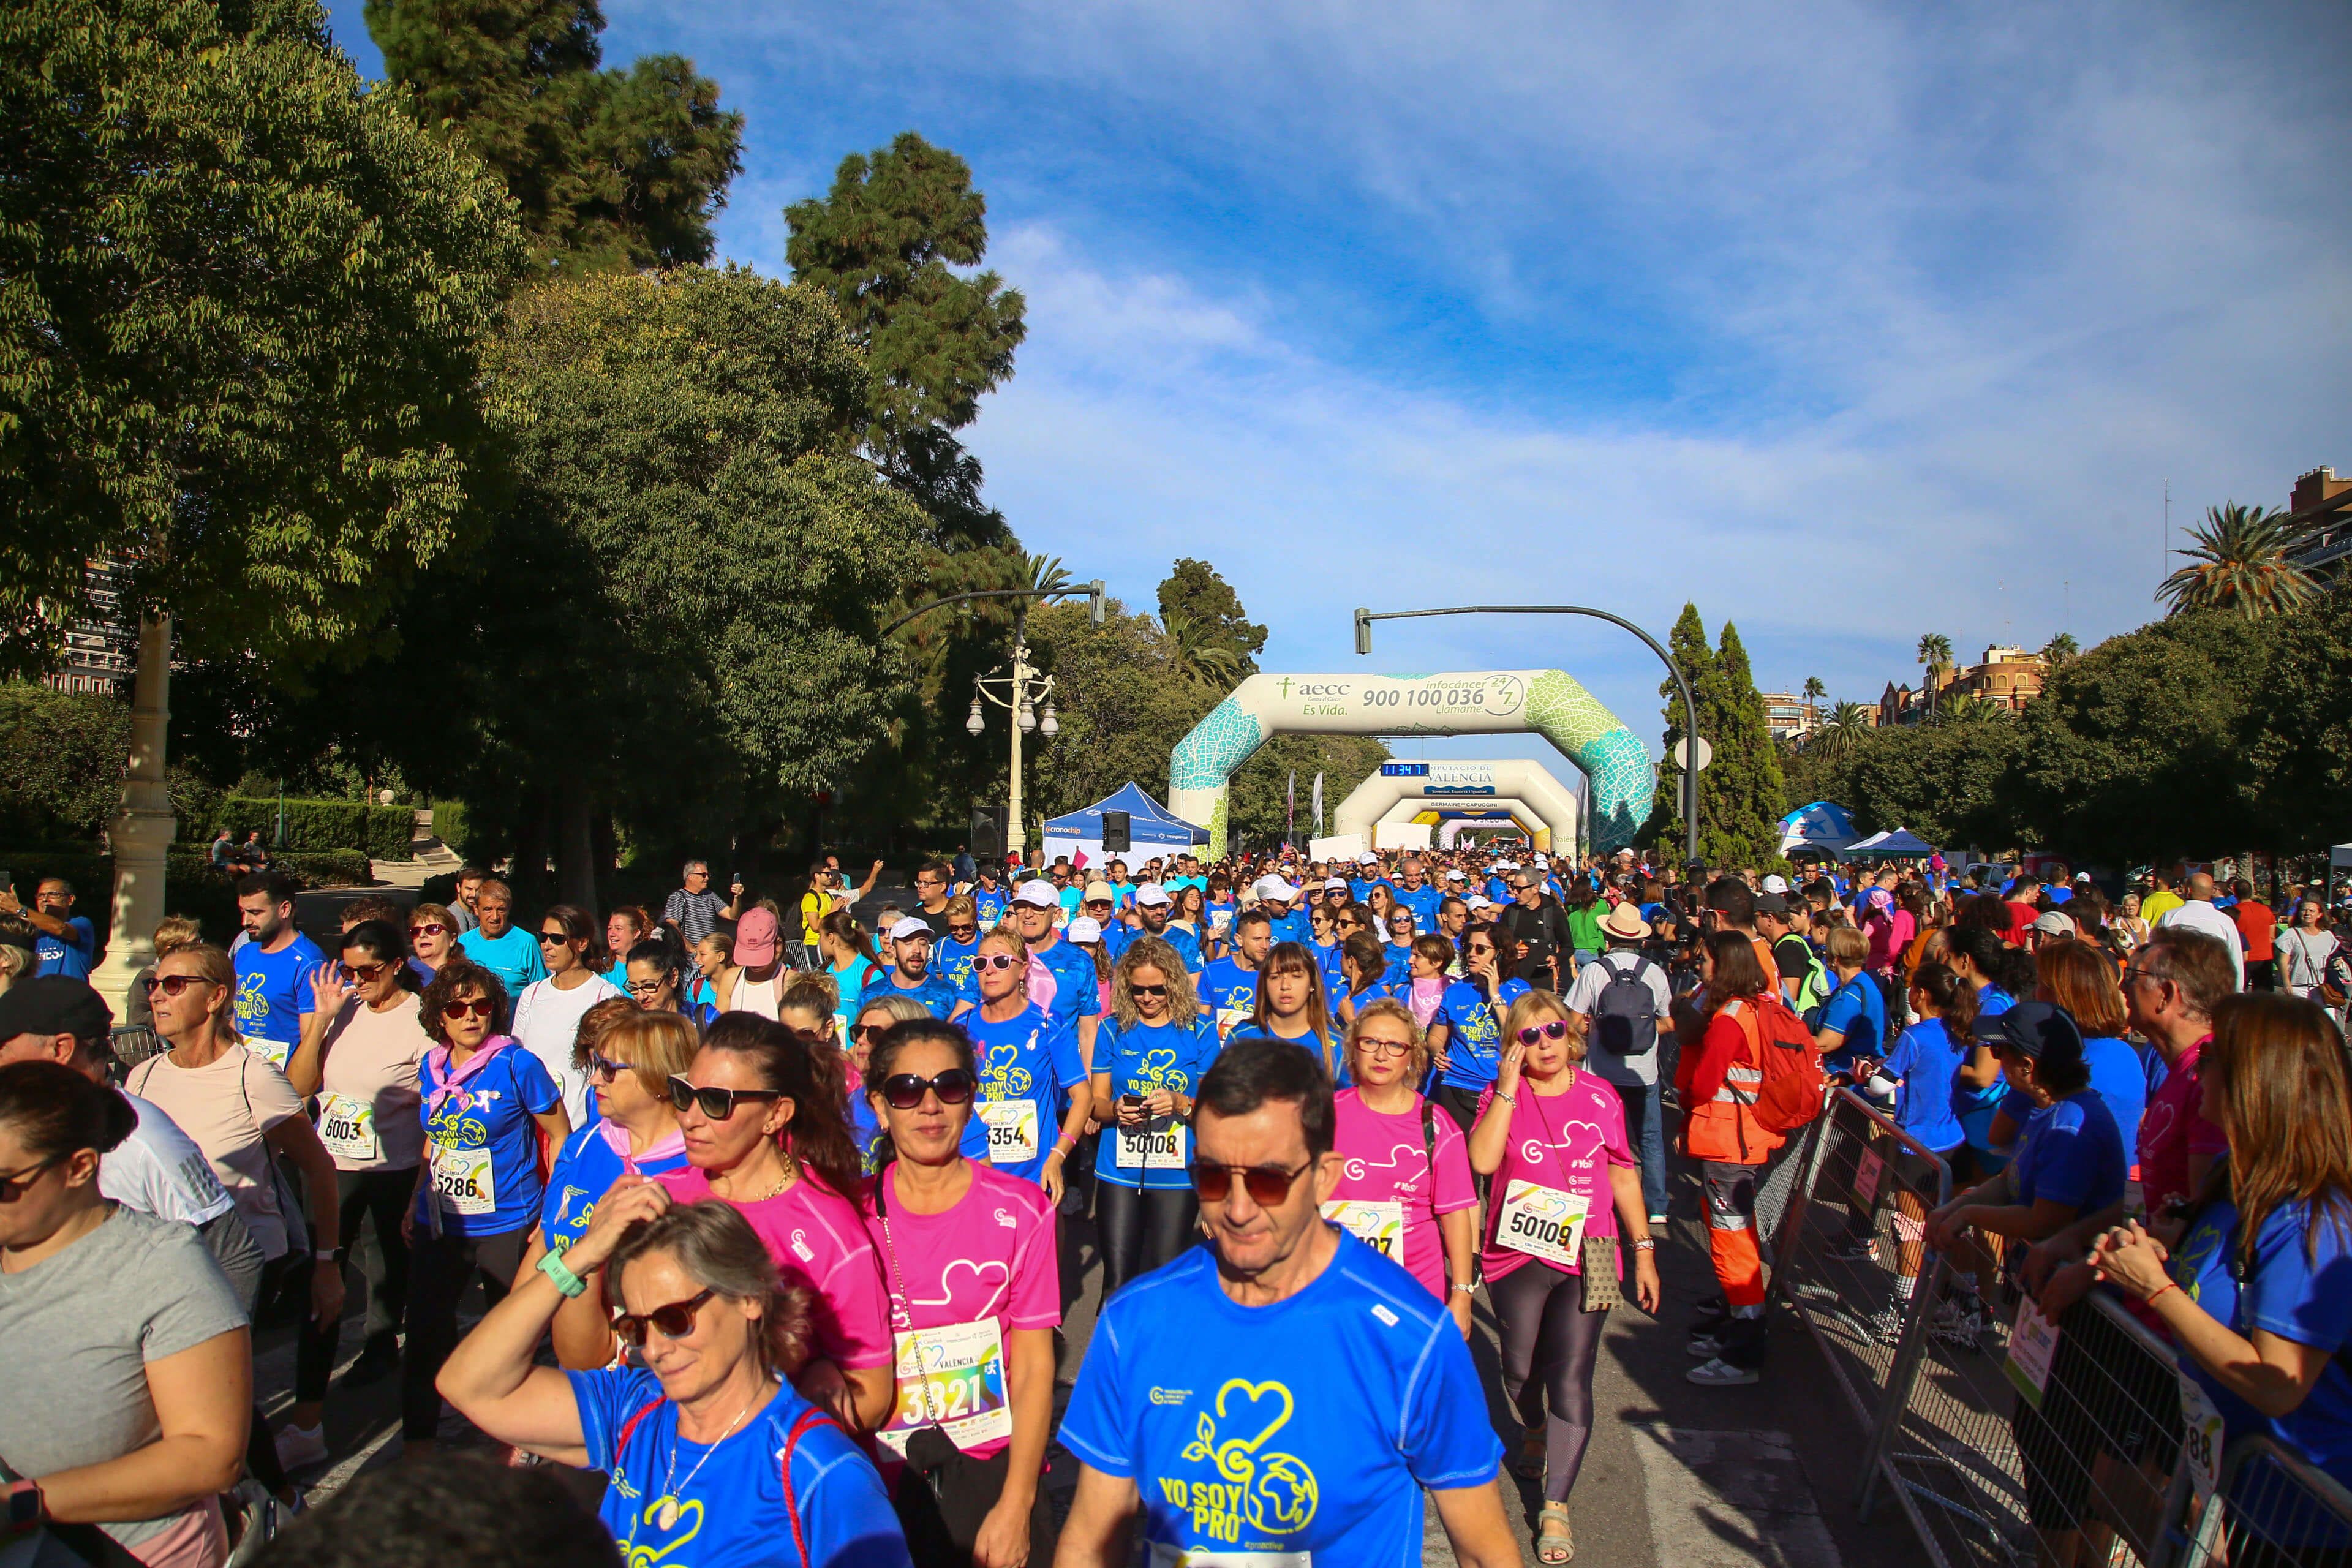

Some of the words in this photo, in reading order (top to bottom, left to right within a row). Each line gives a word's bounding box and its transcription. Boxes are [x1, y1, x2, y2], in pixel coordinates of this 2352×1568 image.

[1299, 684, 1351, 695] aecc
[1426, 680, 1487, 690] infocáncer
[1363, 690, 1400, 706] 900
[1408, 689, 1442, 706] 100
[1447, 688, 1484, 705] 036
[1502, 692, 1513, 704] 7
[1303, 705, 1316, 715] Es
[1318, 704, 1348, 715] Vida.
[1436, 703, 1483, 714] Llámame.
[1428, 772, 1492, 782] VALÈNCIA
[1050, 826, 1081, 835] cronochip
[1458, 1025, 1468, 1033] YO
[1468, 1025, 1482, 1035] SOY
[986, 1081, 1004, 1093] SOY
[1127, 1079, 1139, 1089] YO
[1141, 1081, 1161, 1091] SOY
[325, 1118, 362, 1140] 6003
[1125, 1134, 1177, 1154] 50108
[437, 1173, 477, 1197] 5286
[1510, 1211, 1573, 1247] 50109
[939, 1357, 974, 1370] VALÈNCIA
[902, 1374, 981, 1425] 3821
[1158, 1477, 1188, 1509] YO
[1191, 1481, 1243, 1514] SOY
